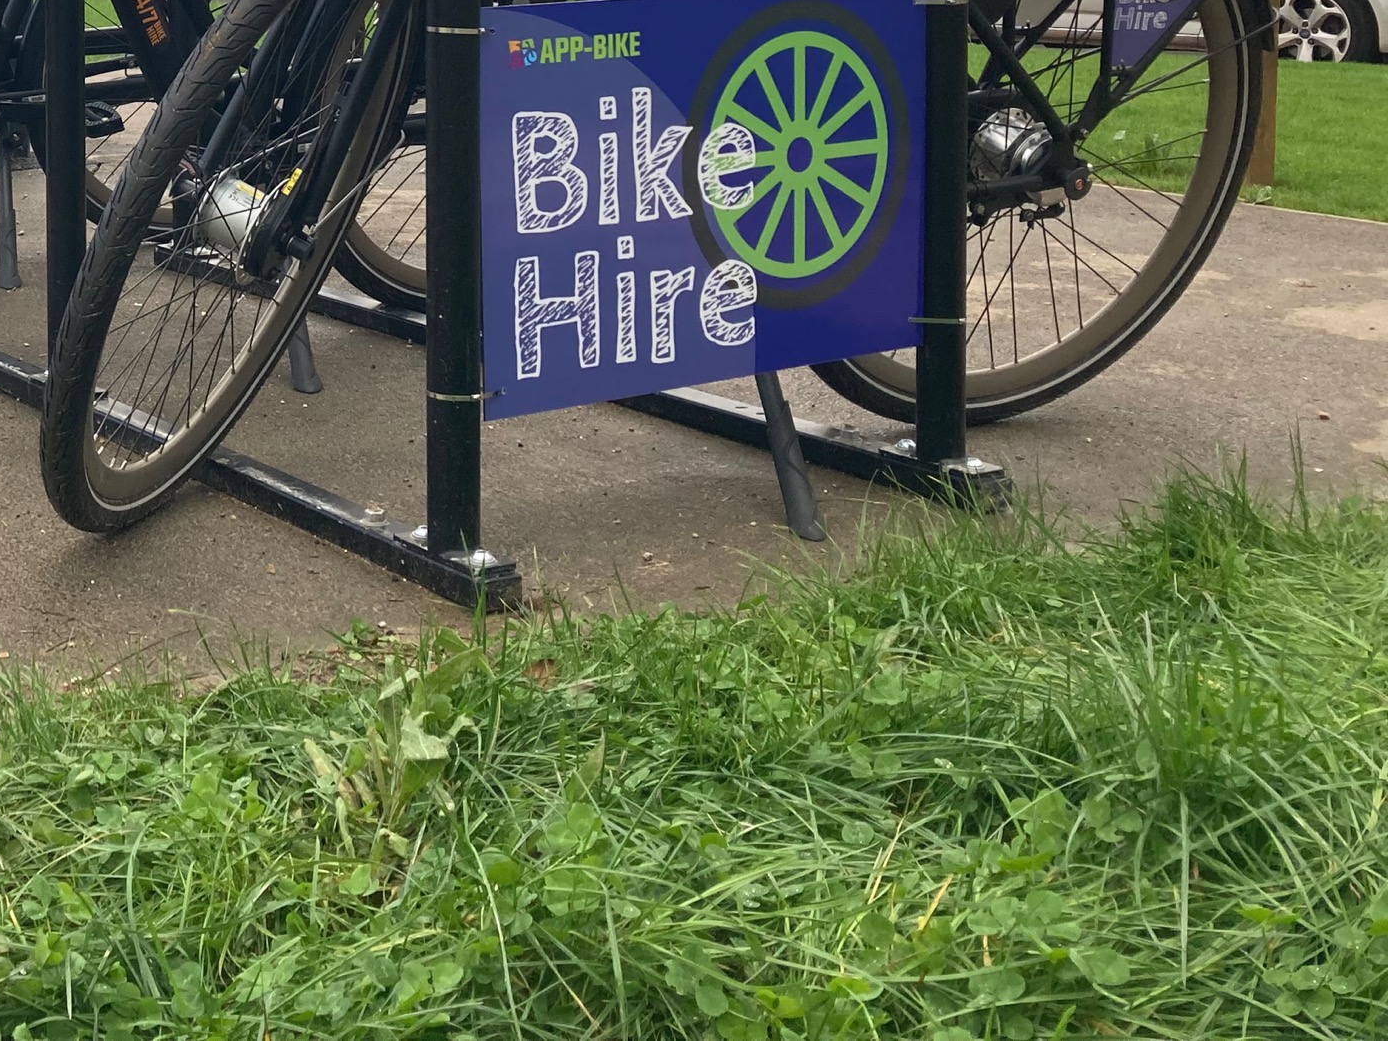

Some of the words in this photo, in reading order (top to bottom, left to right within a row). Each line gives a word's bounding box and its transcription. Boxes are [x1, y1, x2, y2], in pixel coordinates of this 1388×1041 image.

[153, 20, 167, 41] BIKE
[1113, 5, 1169, 32] Hire
[539, 31, 641, 64] APP-BIKE
[512, 87, 756, 234] Bike
[514, 236, 757, 380] Hire
